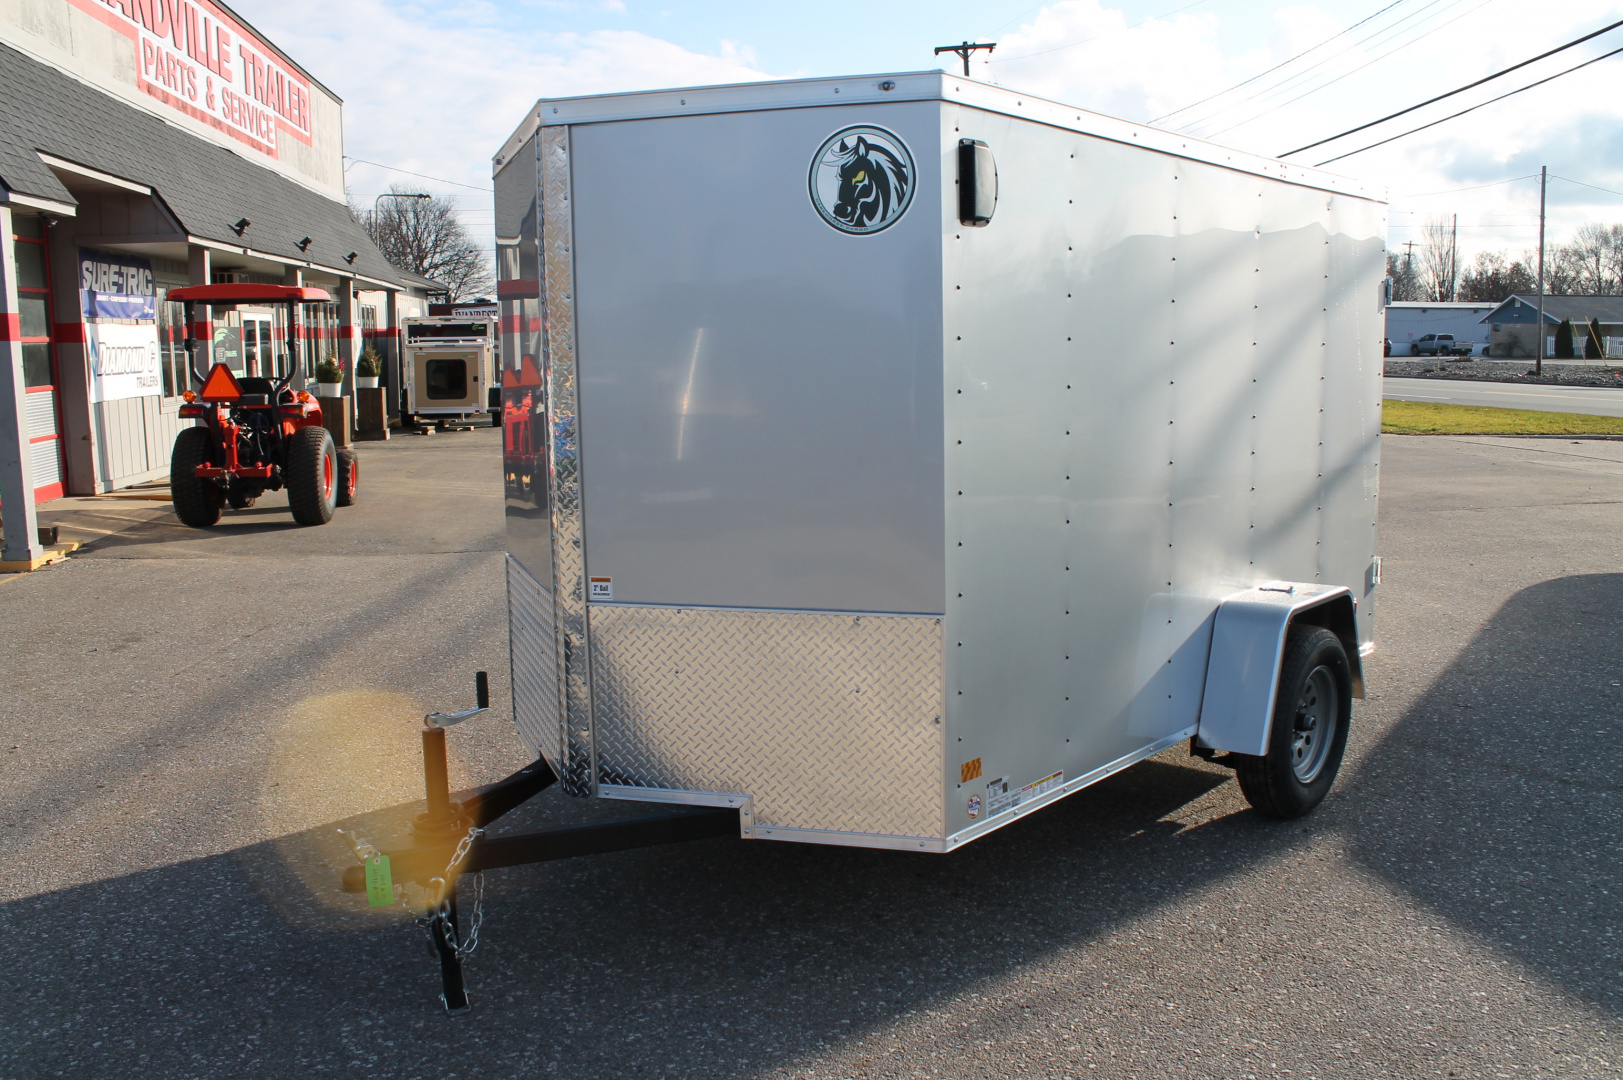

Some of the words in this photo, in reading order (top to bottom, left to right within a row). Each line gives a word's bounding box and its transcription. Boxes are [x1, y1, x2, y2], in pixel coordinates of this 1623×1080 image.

[105, 0, 233, 83] DVILLE
[240, 44, 309, 133] TRAILER
[143, 37, 198, 102] PARTS
[206, 76, 216, 111] &
[222, 86, 275, 144] SERVICE
[82, 260, 153, 296] SURE-TRAC
[97, 341, 145, 377] DIAMOND
[136, 375, 159, 388] TRAILERS
